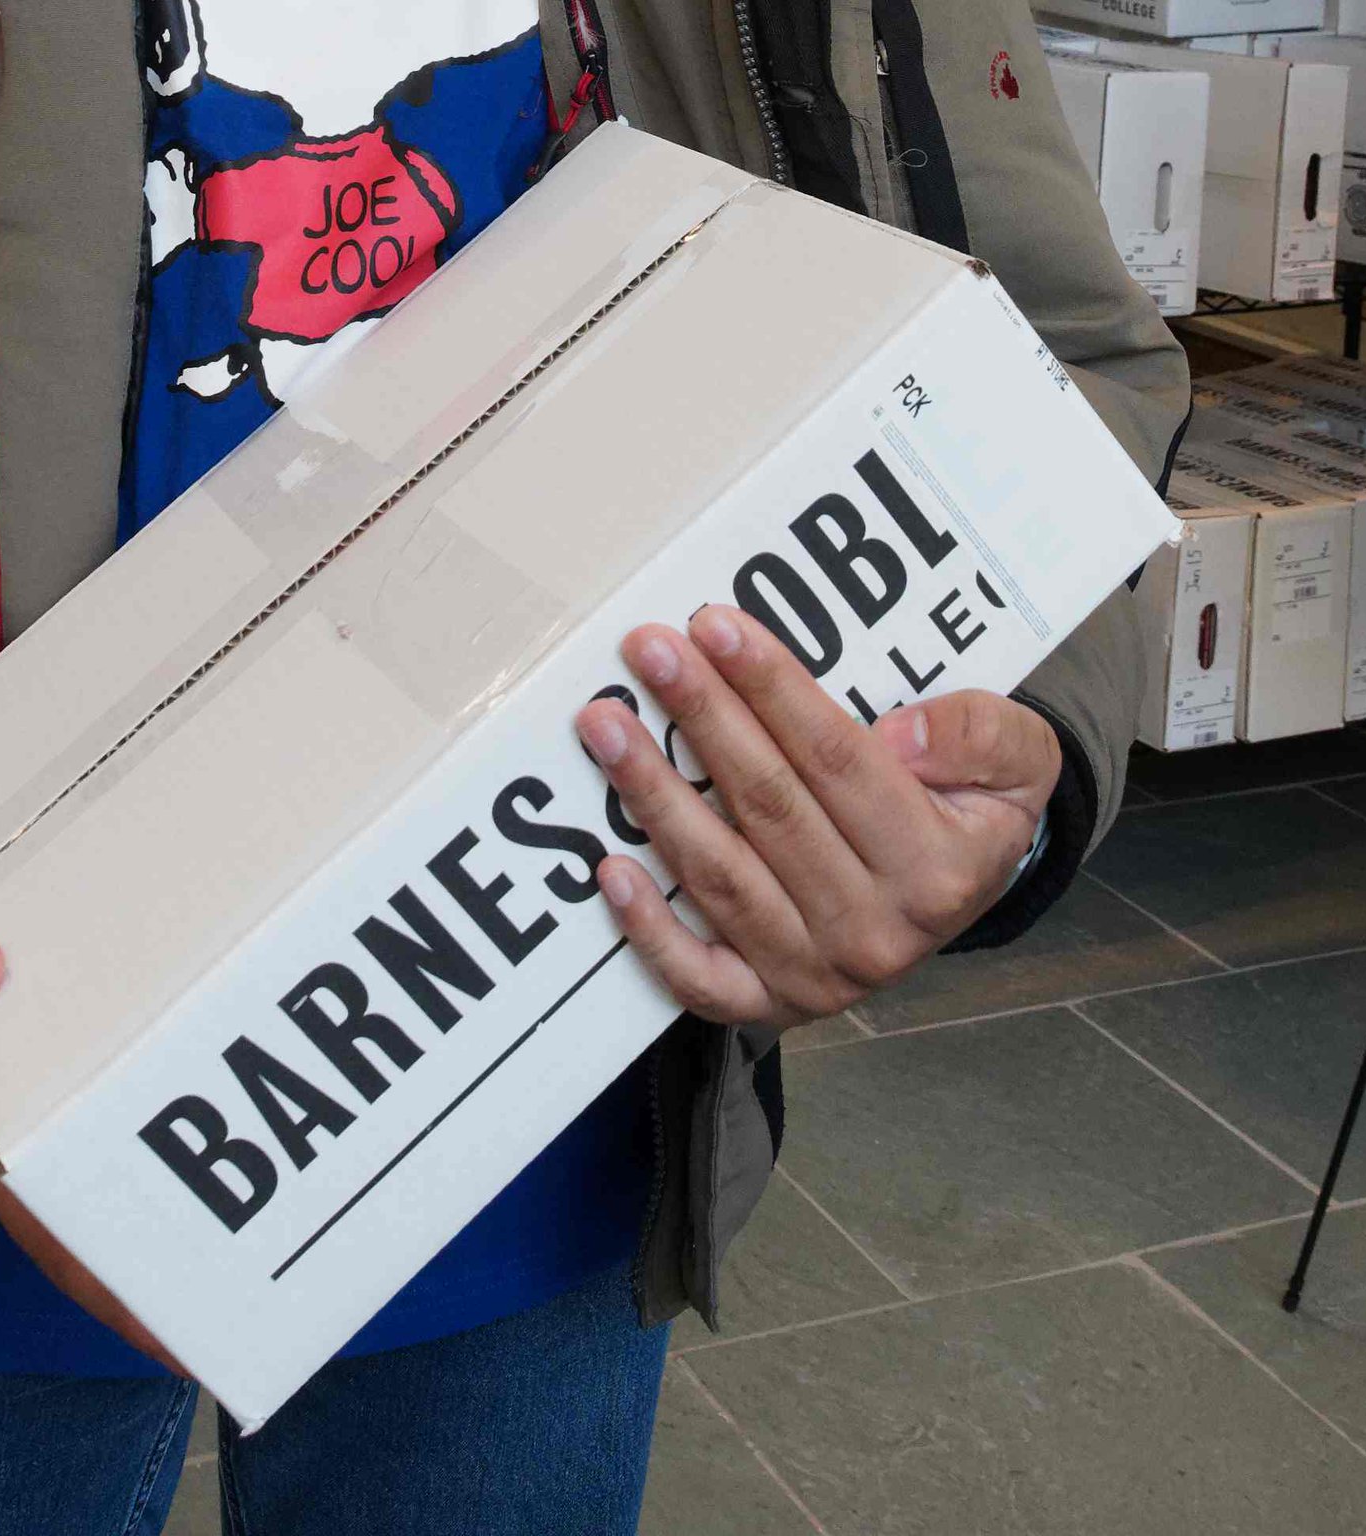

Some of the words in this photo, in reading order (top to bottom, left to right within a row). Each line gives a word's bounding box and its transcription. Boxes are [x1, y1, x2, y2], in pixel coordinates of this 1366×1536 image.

[302, 175, 399, 240] JOE
[892, 373, 932, 418] PCK
[136, 772, 608, 1235] BARNES
[732, 447, 959, 679] OBL
